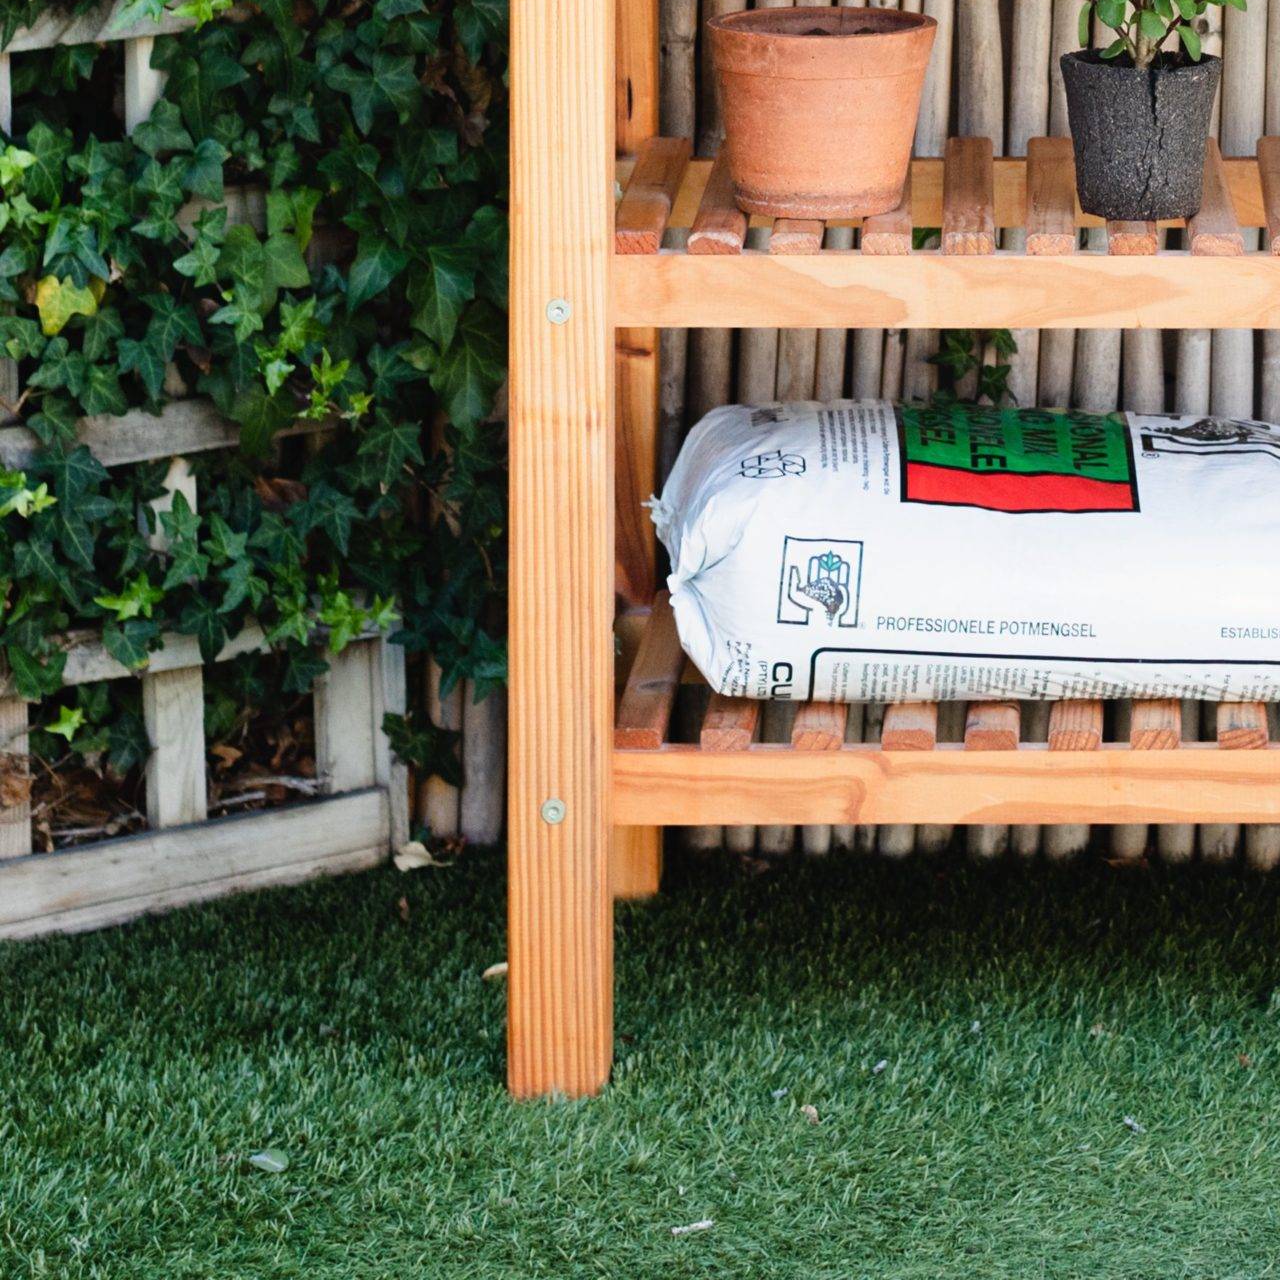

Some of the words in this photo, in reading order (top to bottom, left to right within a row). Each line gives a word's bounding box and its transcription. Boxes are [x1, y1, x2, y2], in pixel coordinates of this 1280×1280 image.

[1022, 427, 1059, 458] MIX
[876, 615, 996, 635] PROFESSIONELE
[999, 621, 1098, 638] POTMENGSEL
[770, 661, 793, 700] CU
